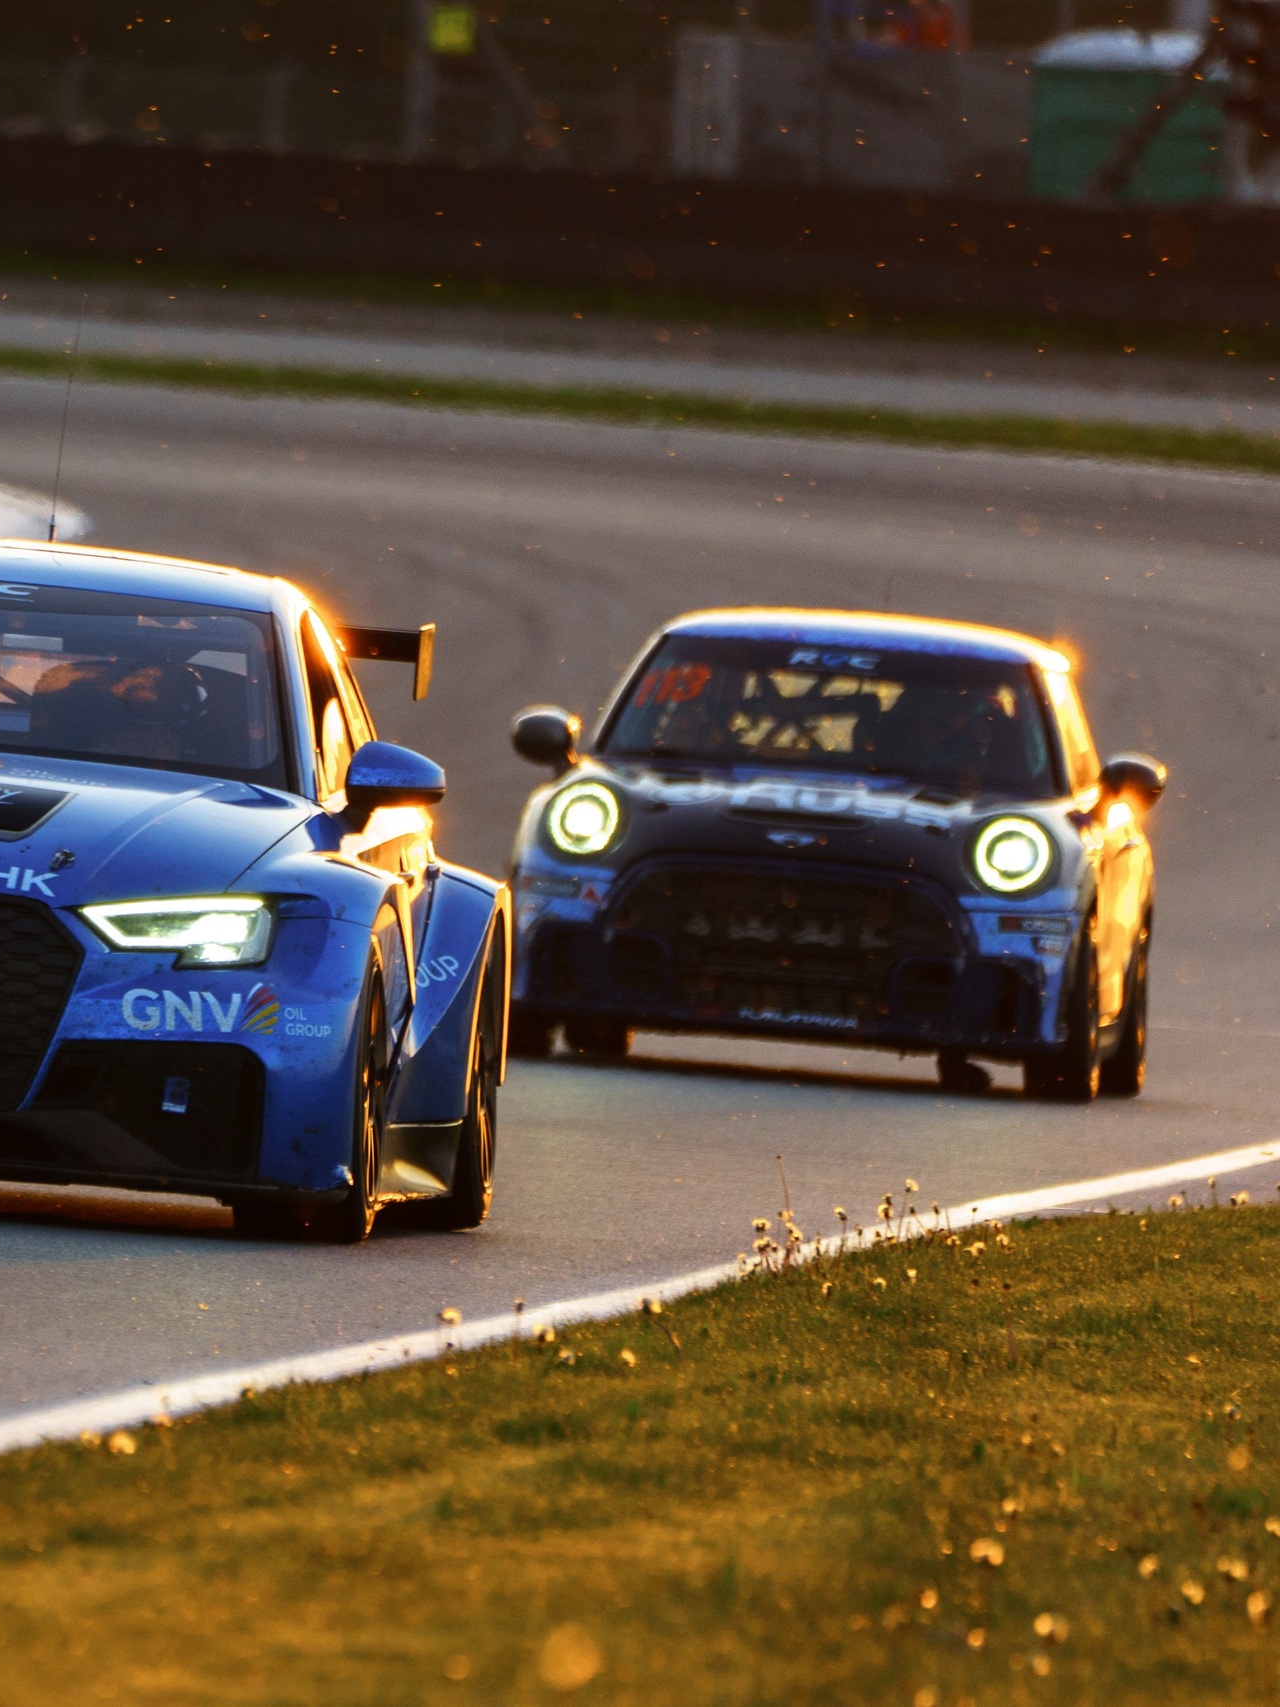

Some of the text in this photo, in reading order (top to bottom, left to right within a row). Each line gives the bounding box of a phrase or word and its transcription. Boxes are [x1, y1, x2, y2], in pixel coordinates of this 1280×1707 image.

[415, 955, 459, 988] OUP
[121, 988, 242, 1033] GNV
[284, 1007, 308, 1020] OIL
[285, 1023, 331, 1037] GROUP
